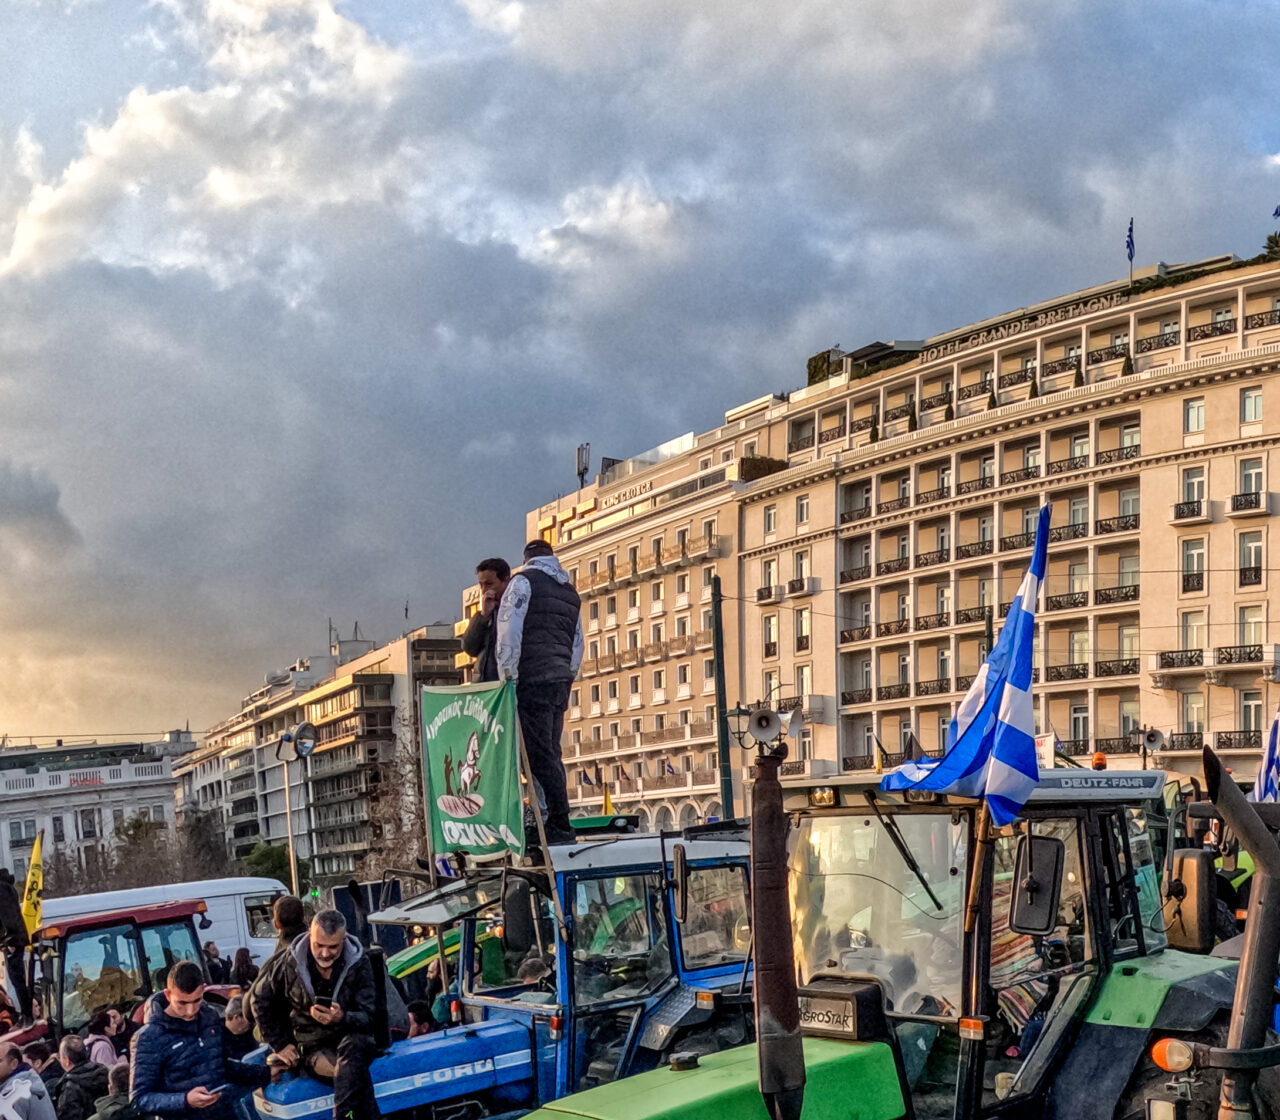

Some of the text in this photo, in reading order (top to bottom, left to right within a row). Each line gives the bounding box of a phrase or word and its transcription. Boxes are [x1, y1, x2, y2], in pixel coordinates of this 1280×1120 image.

[918, 292, 1123, 365] HOTEL GRANDE BRETAGNE
[601, 494, 620, 509] KING
[463, 695, 505, 745] Σύλλογς
[413, 1058, 495, 1088] FORD
